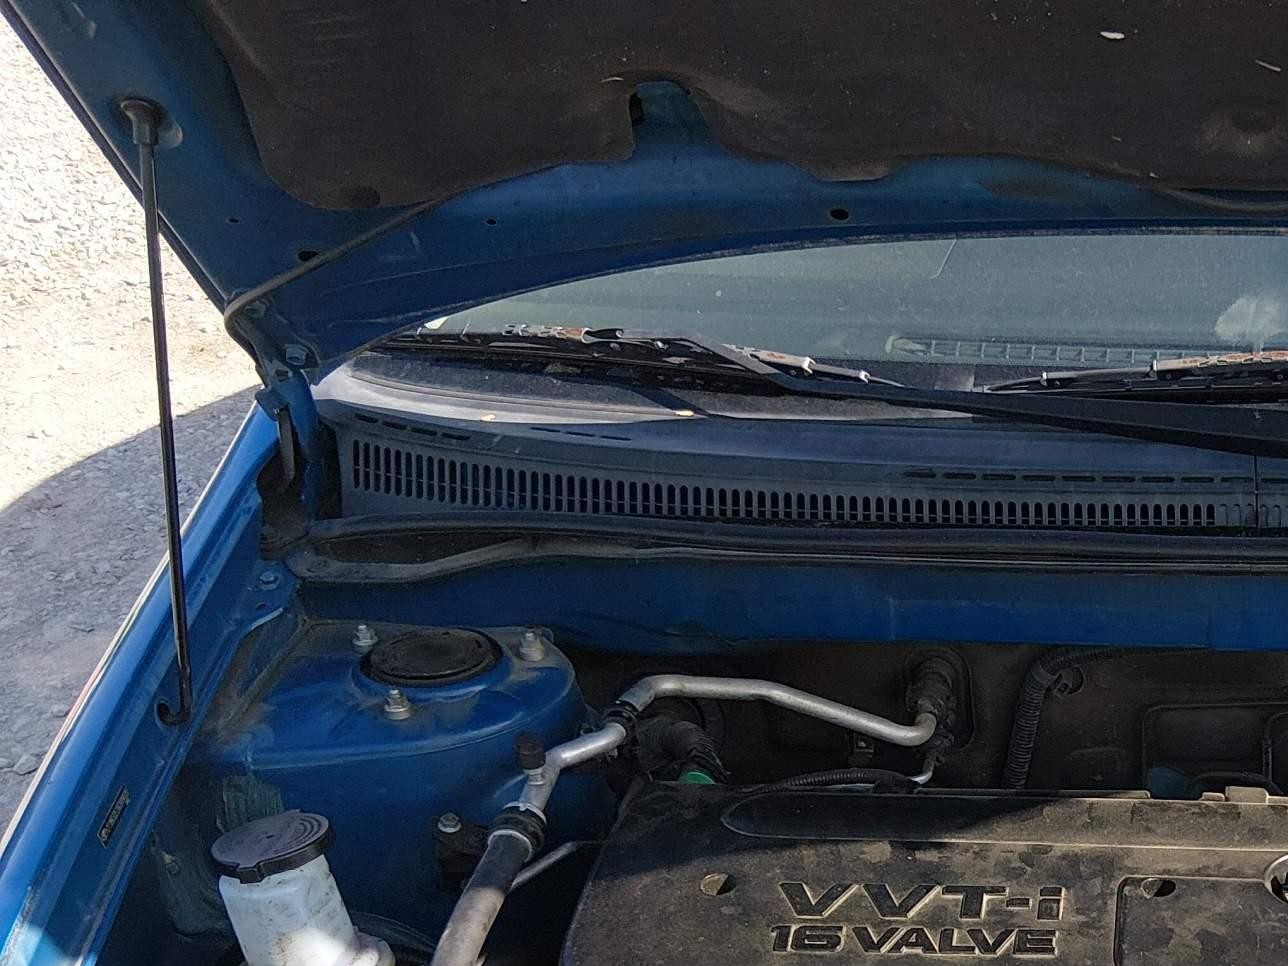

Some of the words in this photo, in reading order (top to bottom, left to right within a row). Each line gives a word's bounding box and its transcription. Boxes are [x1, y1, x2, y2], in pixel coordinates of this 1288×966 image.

[778, 881, 1066, 921] VVT-i
[770, 924, 846, 954] 16
[851, 925, 1060, 957] VALVE
